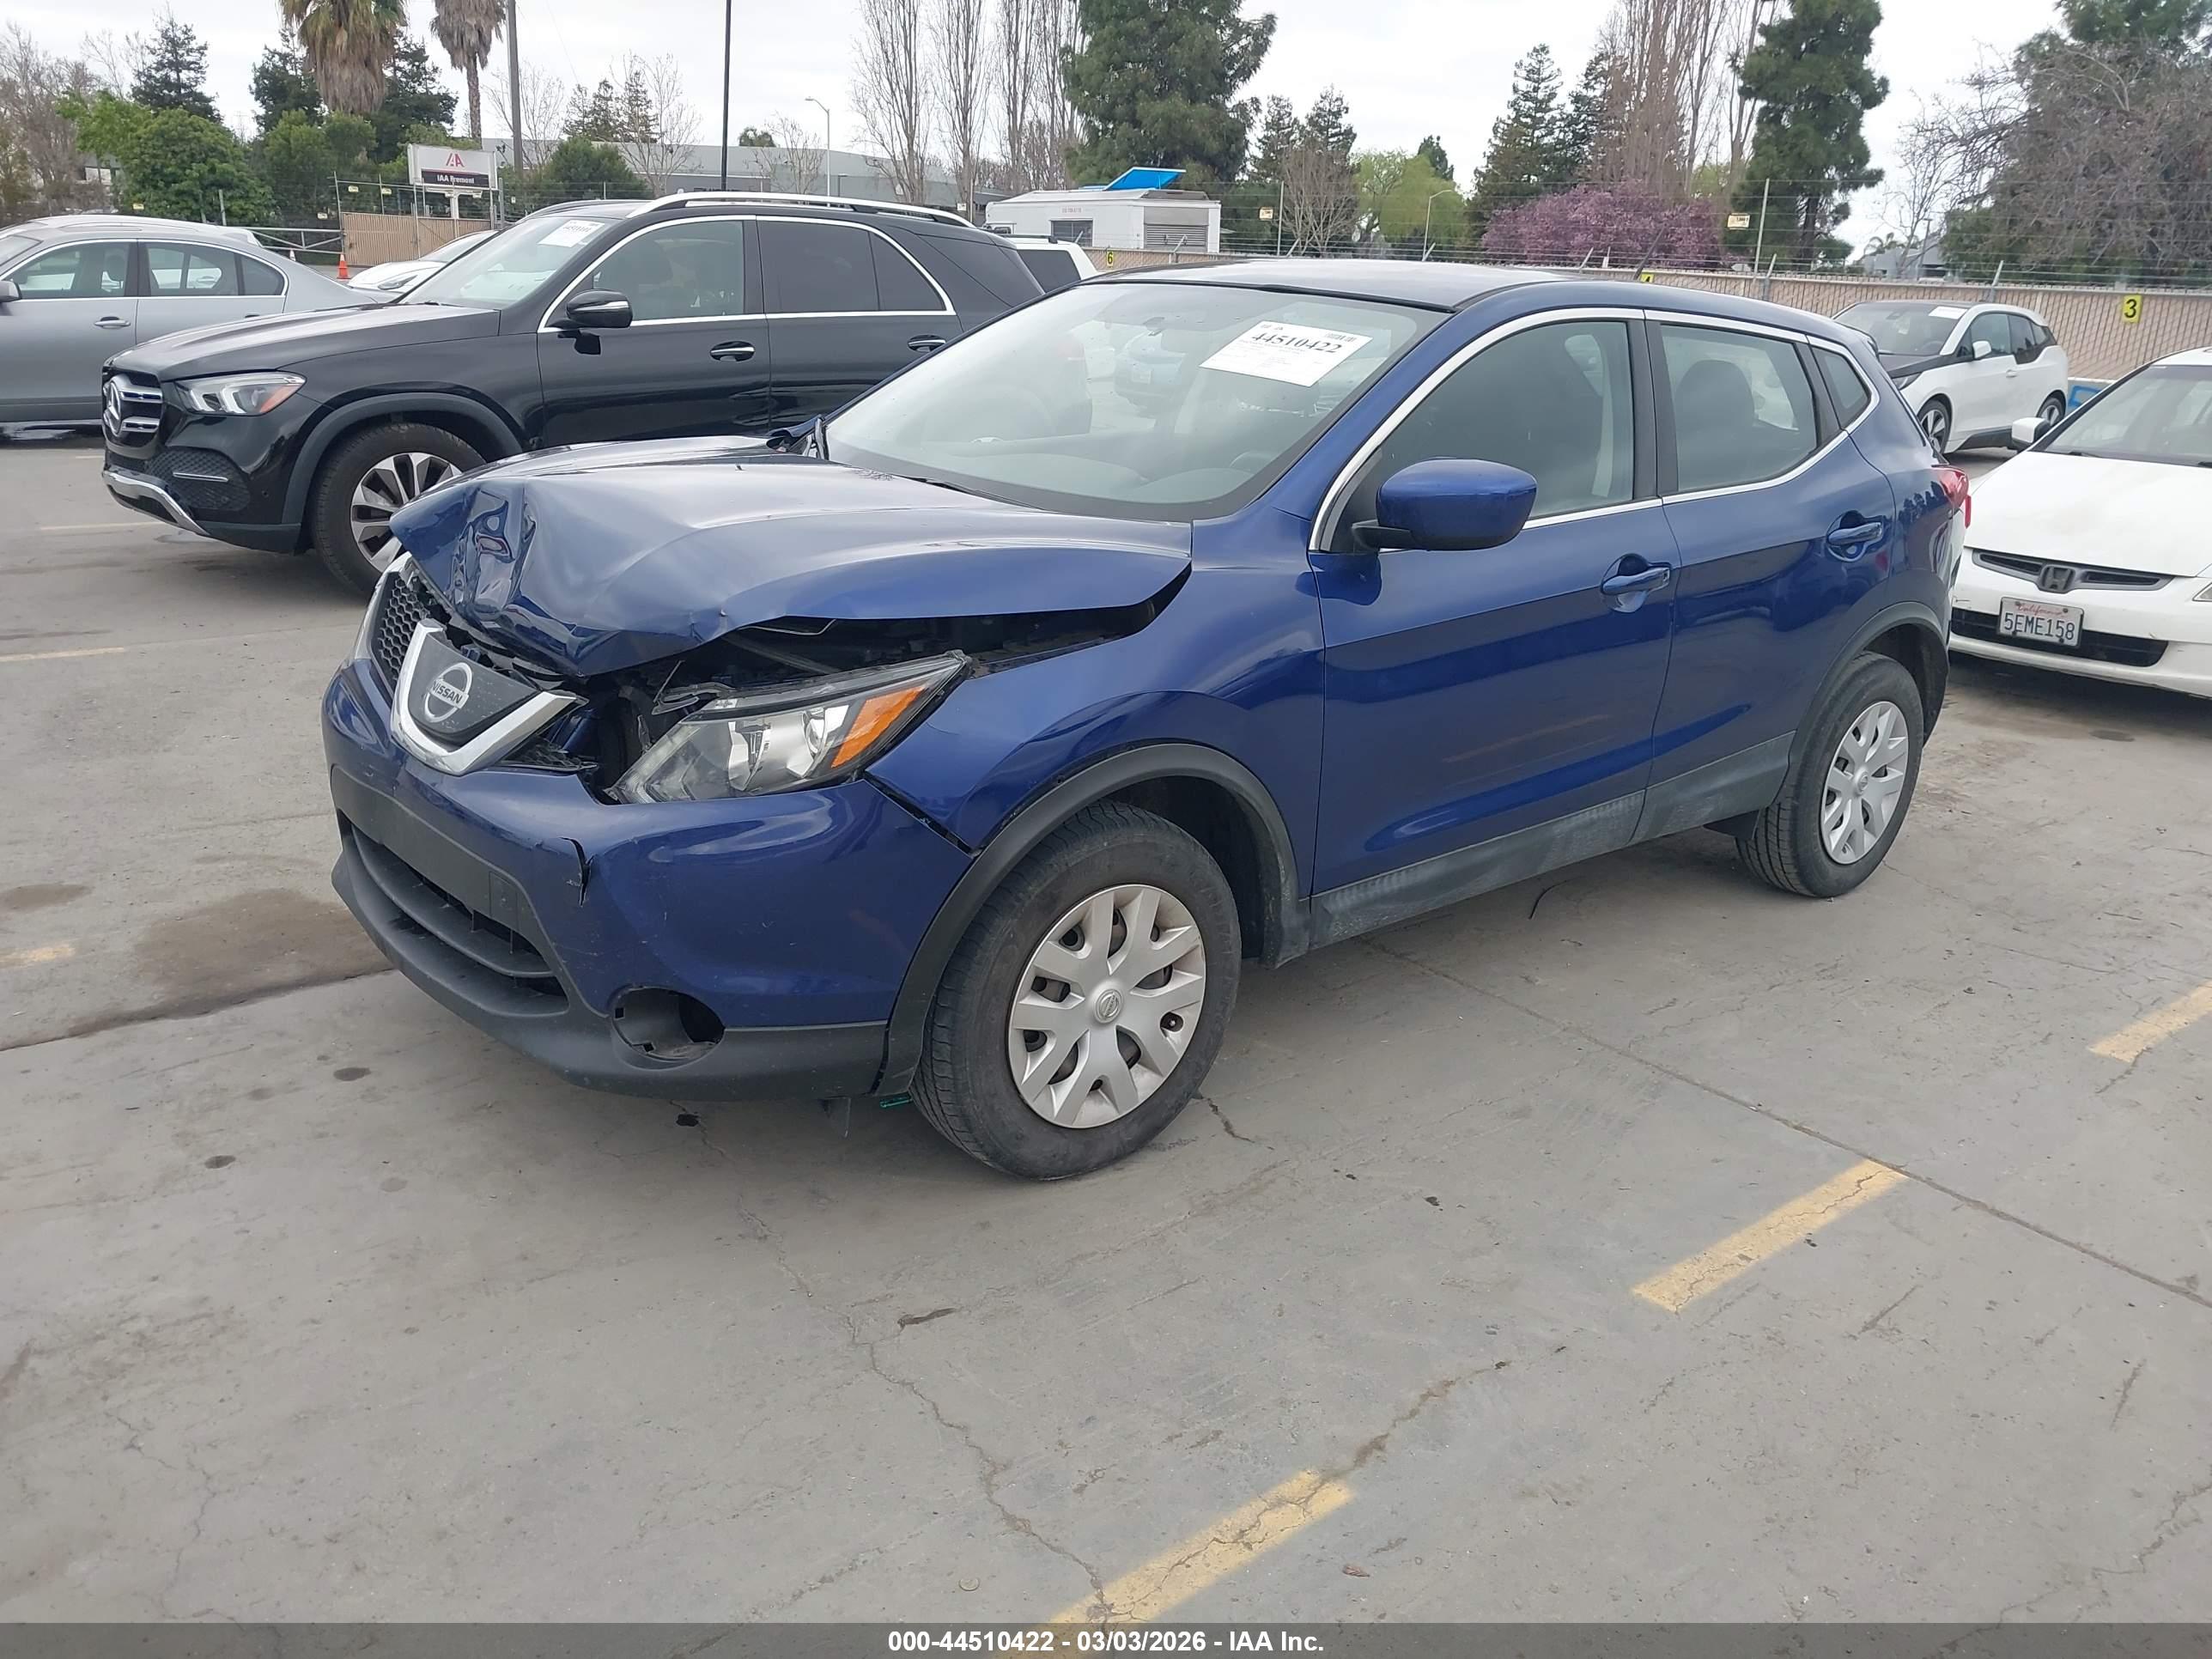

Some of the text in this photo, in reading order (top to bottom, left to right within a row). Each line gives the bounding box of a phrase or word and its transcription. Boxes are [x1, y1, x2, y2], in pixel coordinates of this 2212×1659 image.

[450, 175, 475, 184] Fremont
[1107, 252, 1114, 264] 6
[2124, 298, 2137, 319] 3
[1252, 332, 1342, 353] 44510422
[2004, 612, 2075, 641] 5EME158
[432, 680, 463, 704] NISSAN
